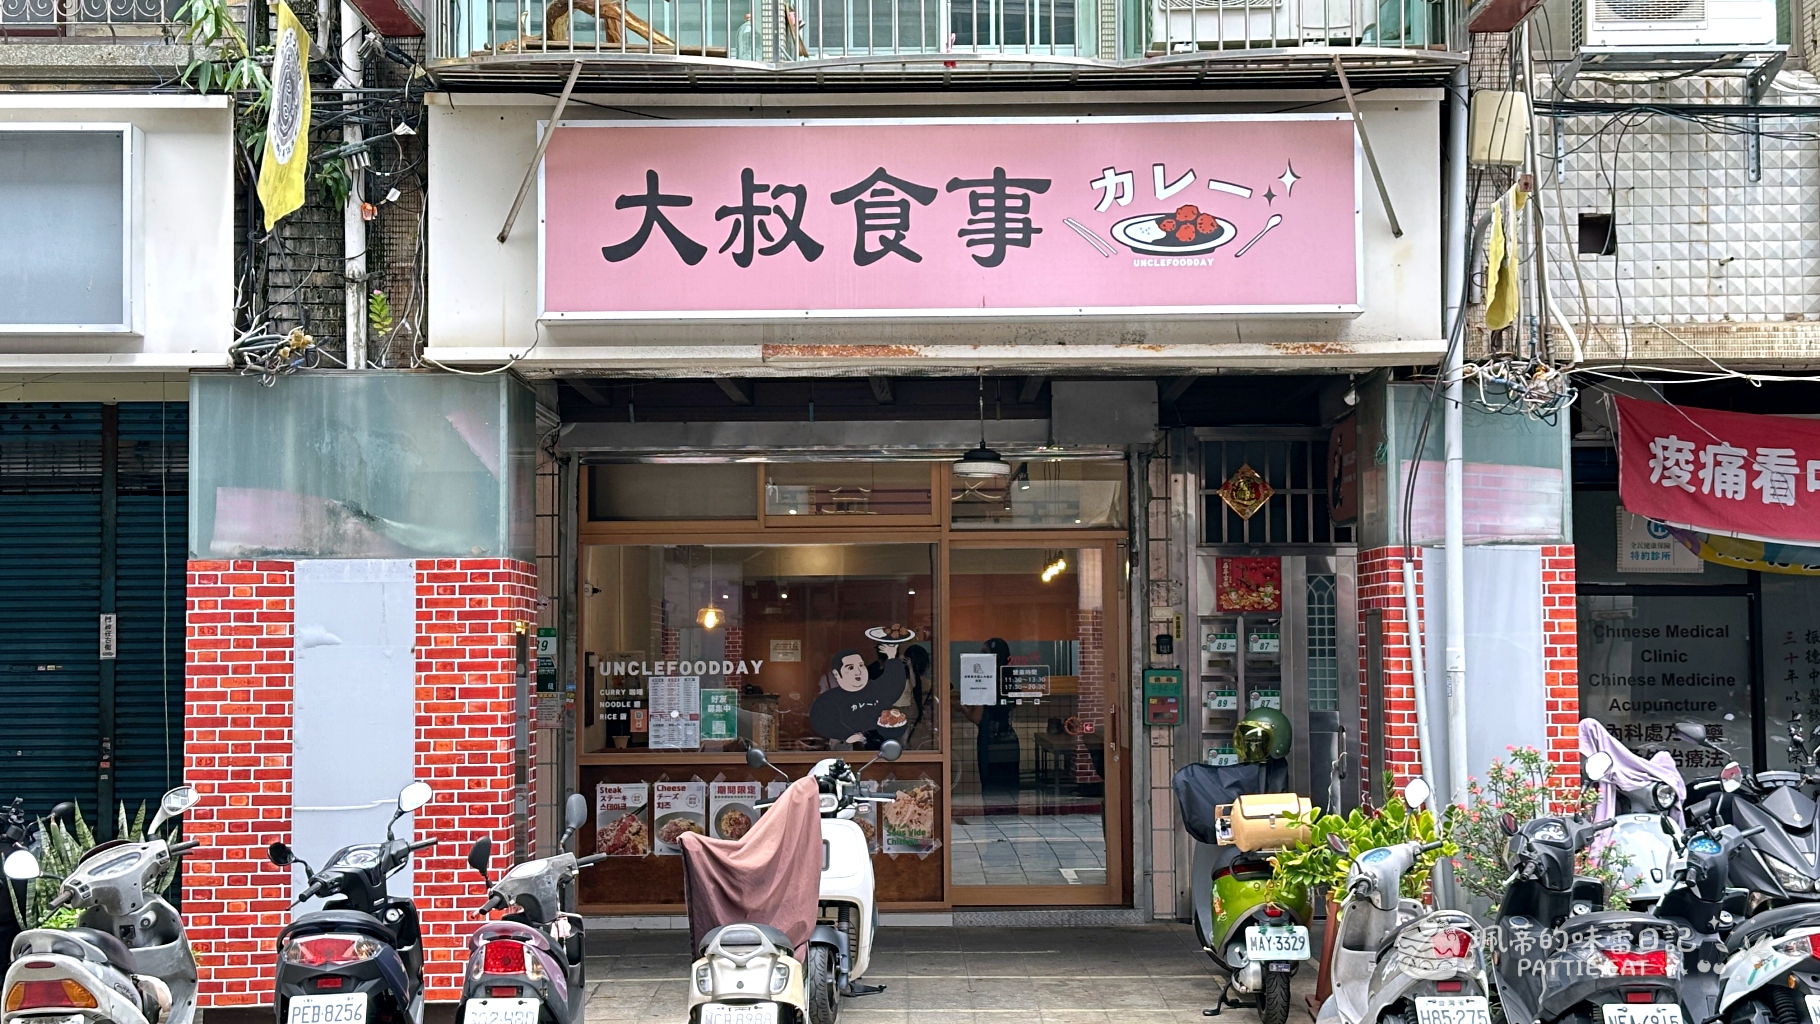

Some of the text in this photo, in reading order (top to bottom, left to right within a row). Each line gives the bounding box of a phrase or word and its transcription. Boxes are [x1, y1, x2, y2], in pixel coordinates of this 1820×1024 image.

[1089, 162, 1253, 213] カレー
[602, 166, 1053, 269] 大叔食事
[1133, 258, 1215, 268] UNCLEFOODDAY
[1630, 551, 1671, 561] 特約診所
[1593, 624, 1730, 638] Chinese Medical
[1216, 642, 1227, 650] 89
[1259, 642, 1270, 650] 87
[1640, 649, 1688, 663] Clinic
[599, 660, 764, 676] UNCLEFOODDAY
[1589, 673, 1736, 687] Chinese Medicine
[599, 688, 626, 696] CURRY
[599, 700, 631, 708] NOODLE
[1217, 699, 1228, 708] 89
[1260, 699, 1271, 708] 87
[1609, 698, 1717, 714] Acupuncture
[599, 712, 617, 720] RICE
[1606, 723, 1724, 742] 內科處方藥
[1218, 757, 1229, 766] 89
[600, 786, 622, 794] Steak
[656, 784, 687, 792] Cheese
[717, 785, 756, 795] 期間限定
[600, 794, 628, 802] ステーキ
[600, 803, 627, 811] 스테이크
[656, 801, 671, 809] 치즈
[886, 828, 926, 837] Sous Vide
